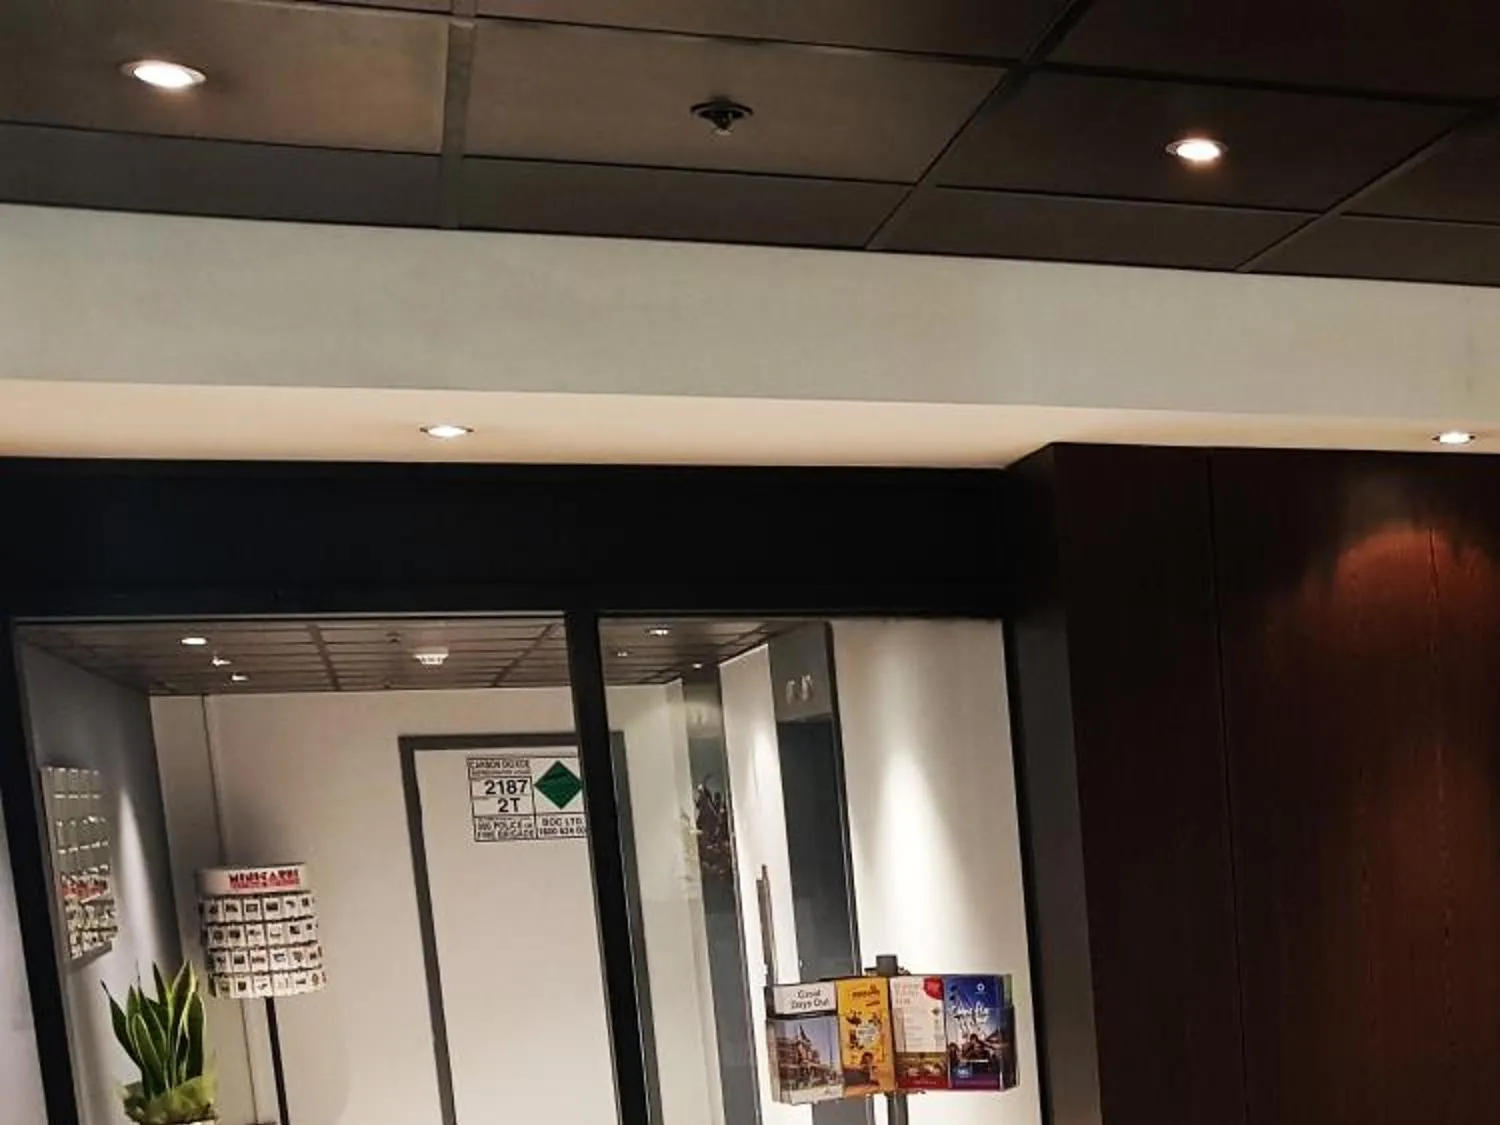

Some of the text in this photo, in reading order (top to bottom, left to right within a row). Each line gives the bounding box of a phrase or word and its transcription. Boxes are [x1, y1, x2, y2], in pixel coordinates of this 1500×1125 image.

[484, 779, 528, 795] 2187
[497, 797, 521, 813] 2T
[797, 988, 822, 998] Good
[791, 998, 829, 1010] Days Out
